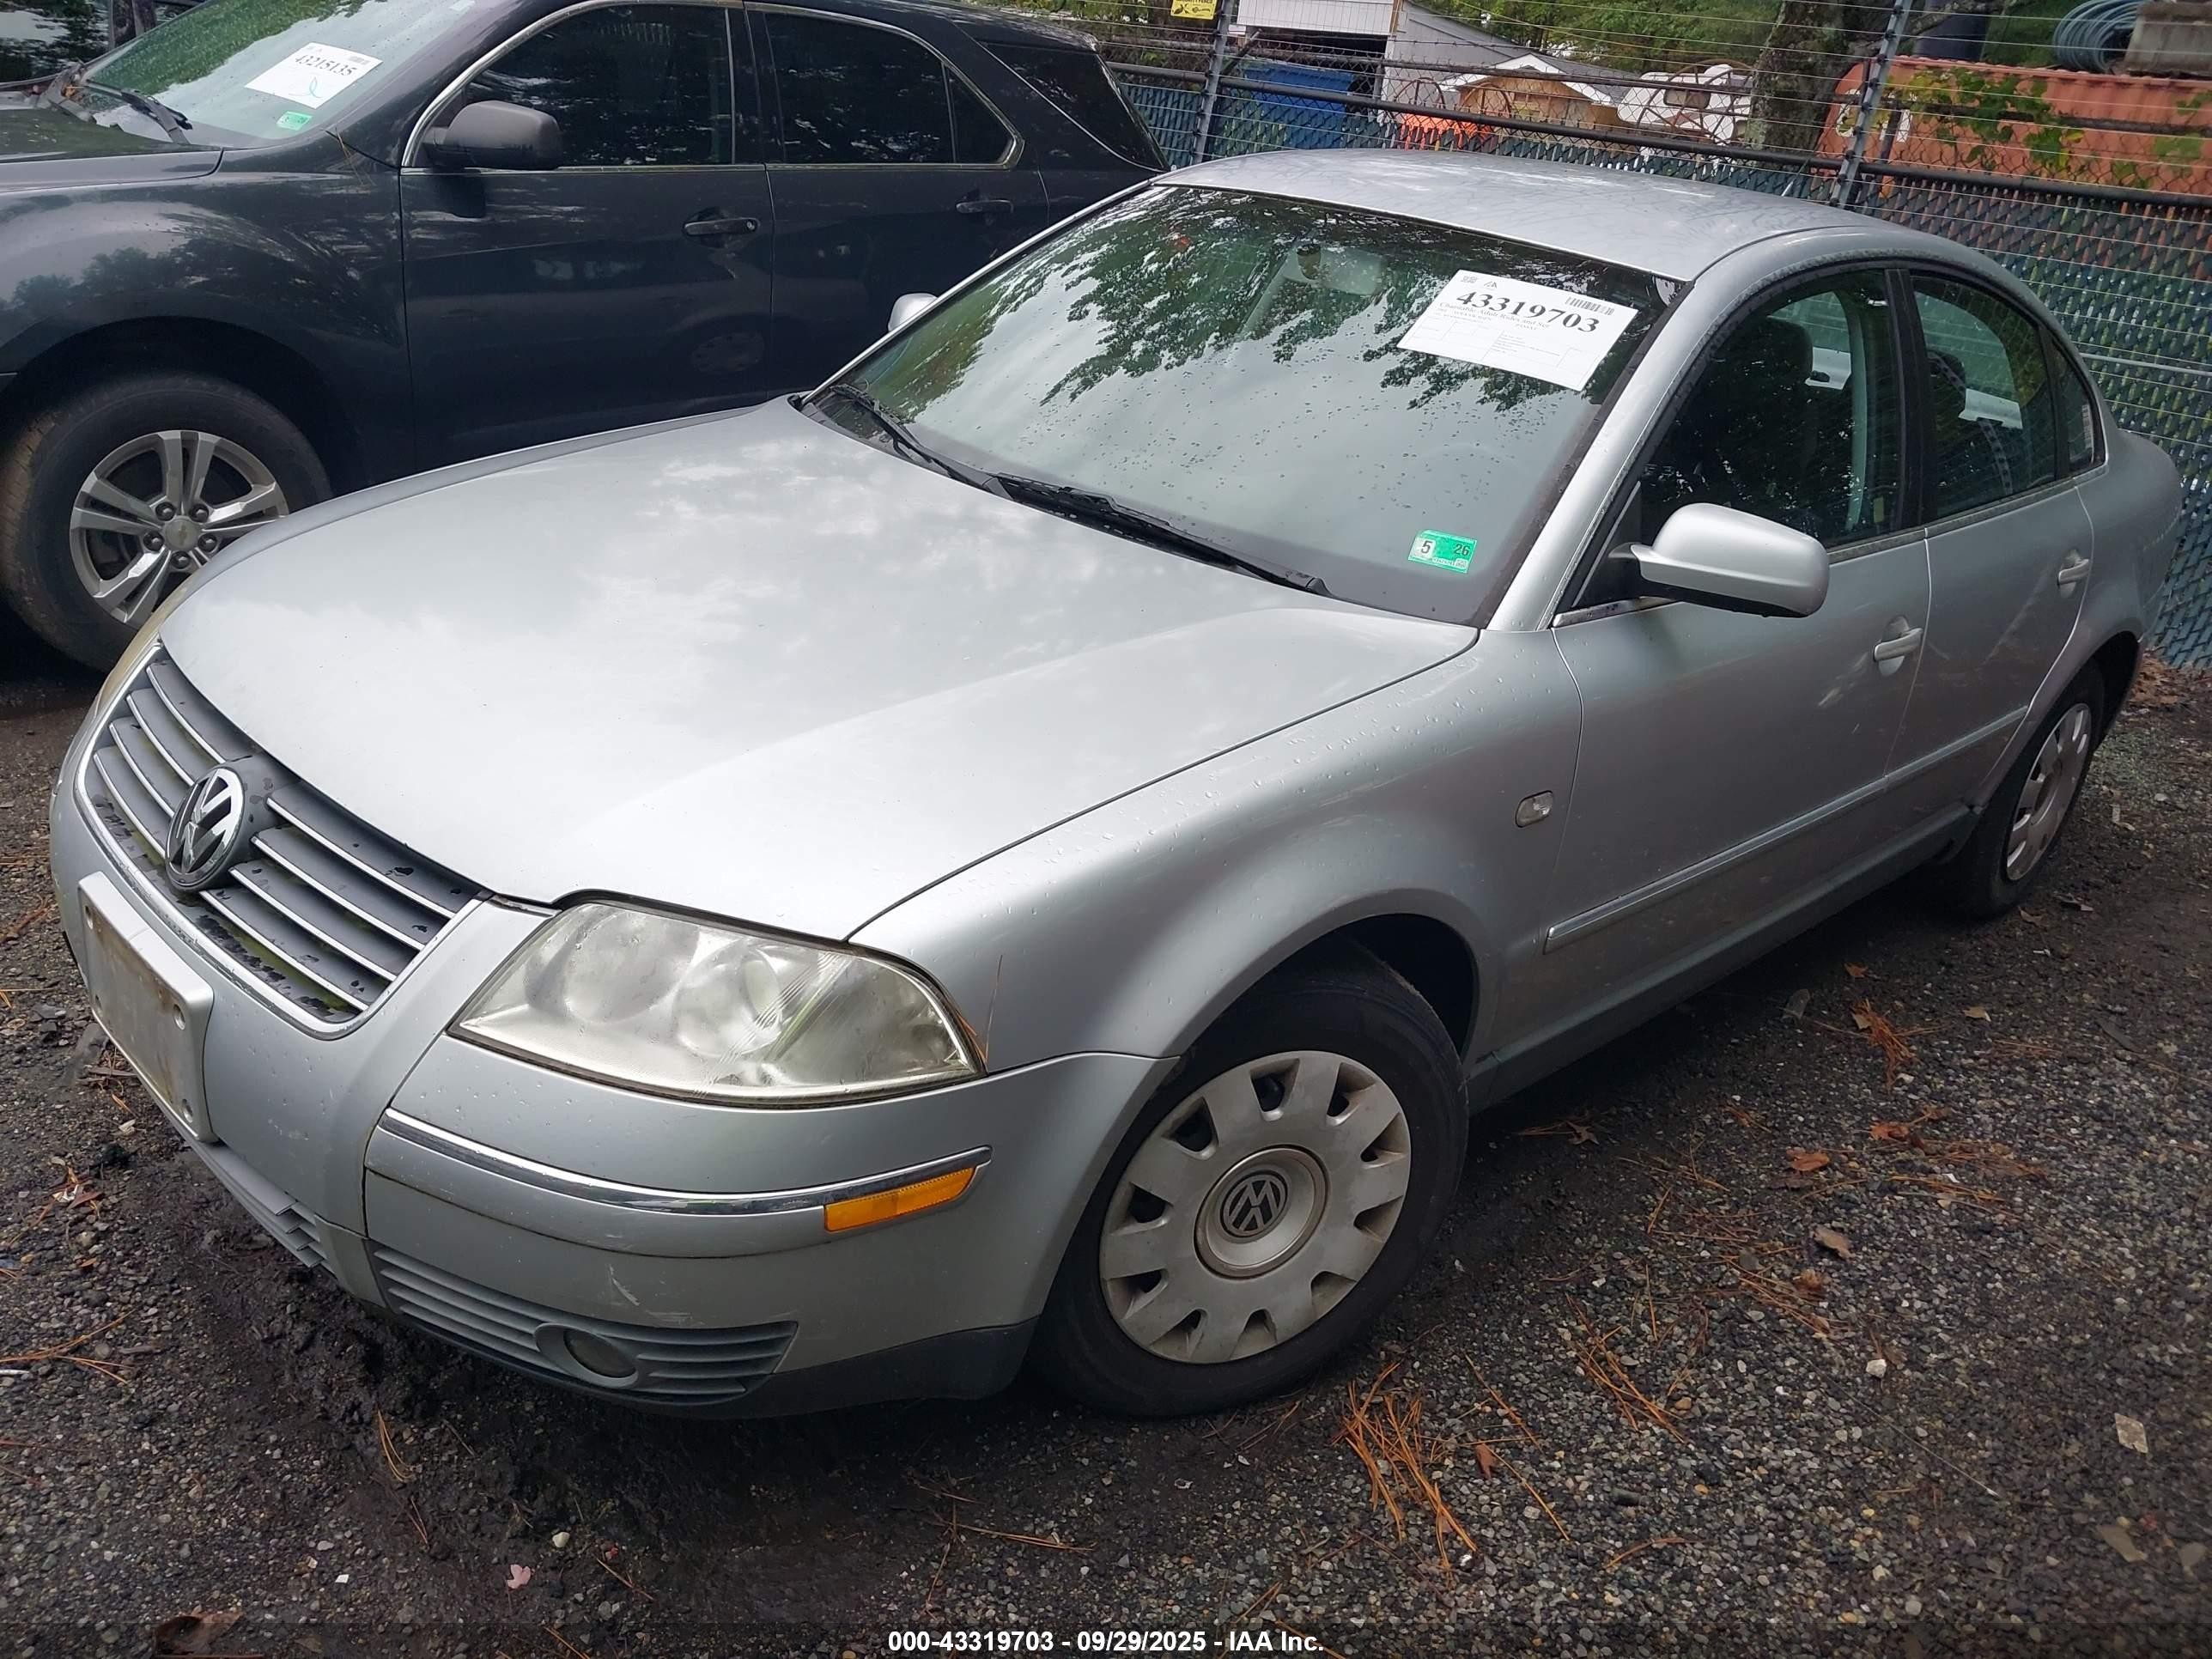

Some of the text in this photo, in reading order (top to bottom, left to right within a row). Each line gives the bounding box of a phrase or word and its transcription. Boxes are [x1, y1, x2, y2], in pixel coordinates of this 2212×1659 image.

[295, 54, 358, 76] 43215135
[1455, 291, 1601, 333] 43319703
[1420, 539, 1471, 556] 5 26
